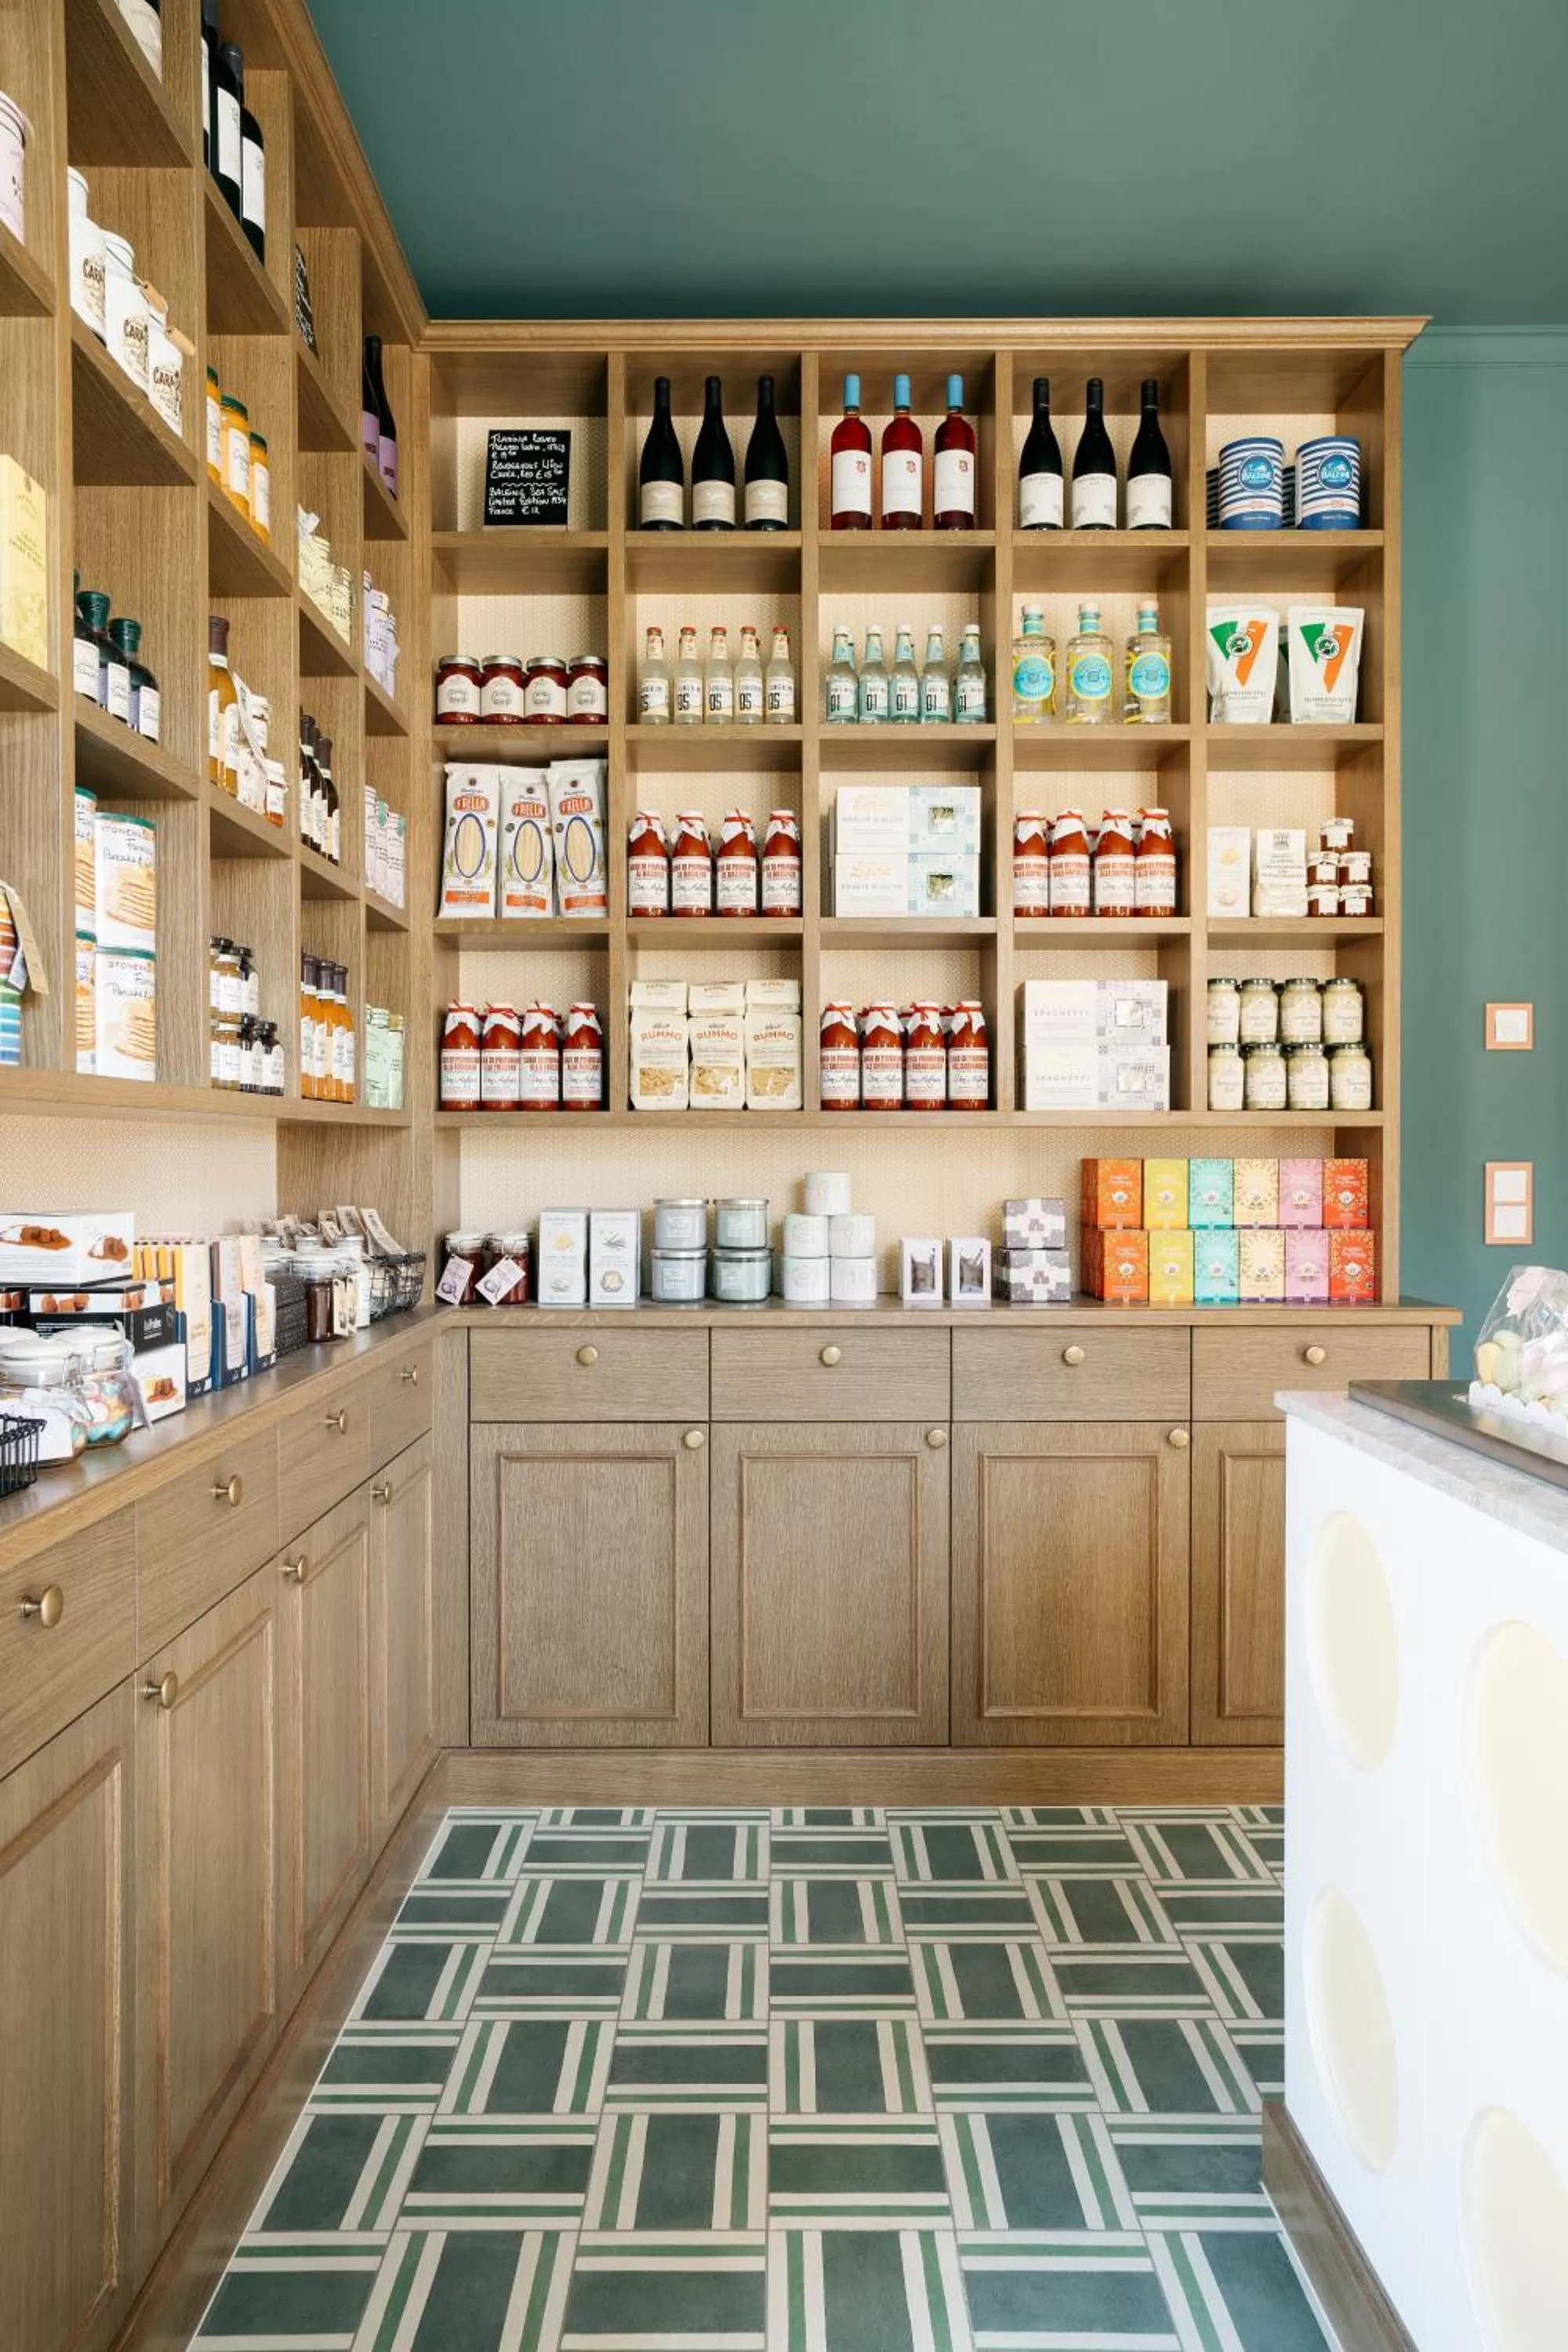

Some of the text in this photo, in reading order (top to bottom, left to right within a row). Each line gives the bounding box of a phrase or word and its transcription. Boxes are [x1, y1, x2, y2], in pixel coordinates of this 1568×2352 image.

[641, 1031, 683, 1041] RUMMO
[696, 1031, 738, 1041] RUMMO
[753, 1031, 794, 1041] RUMMO
